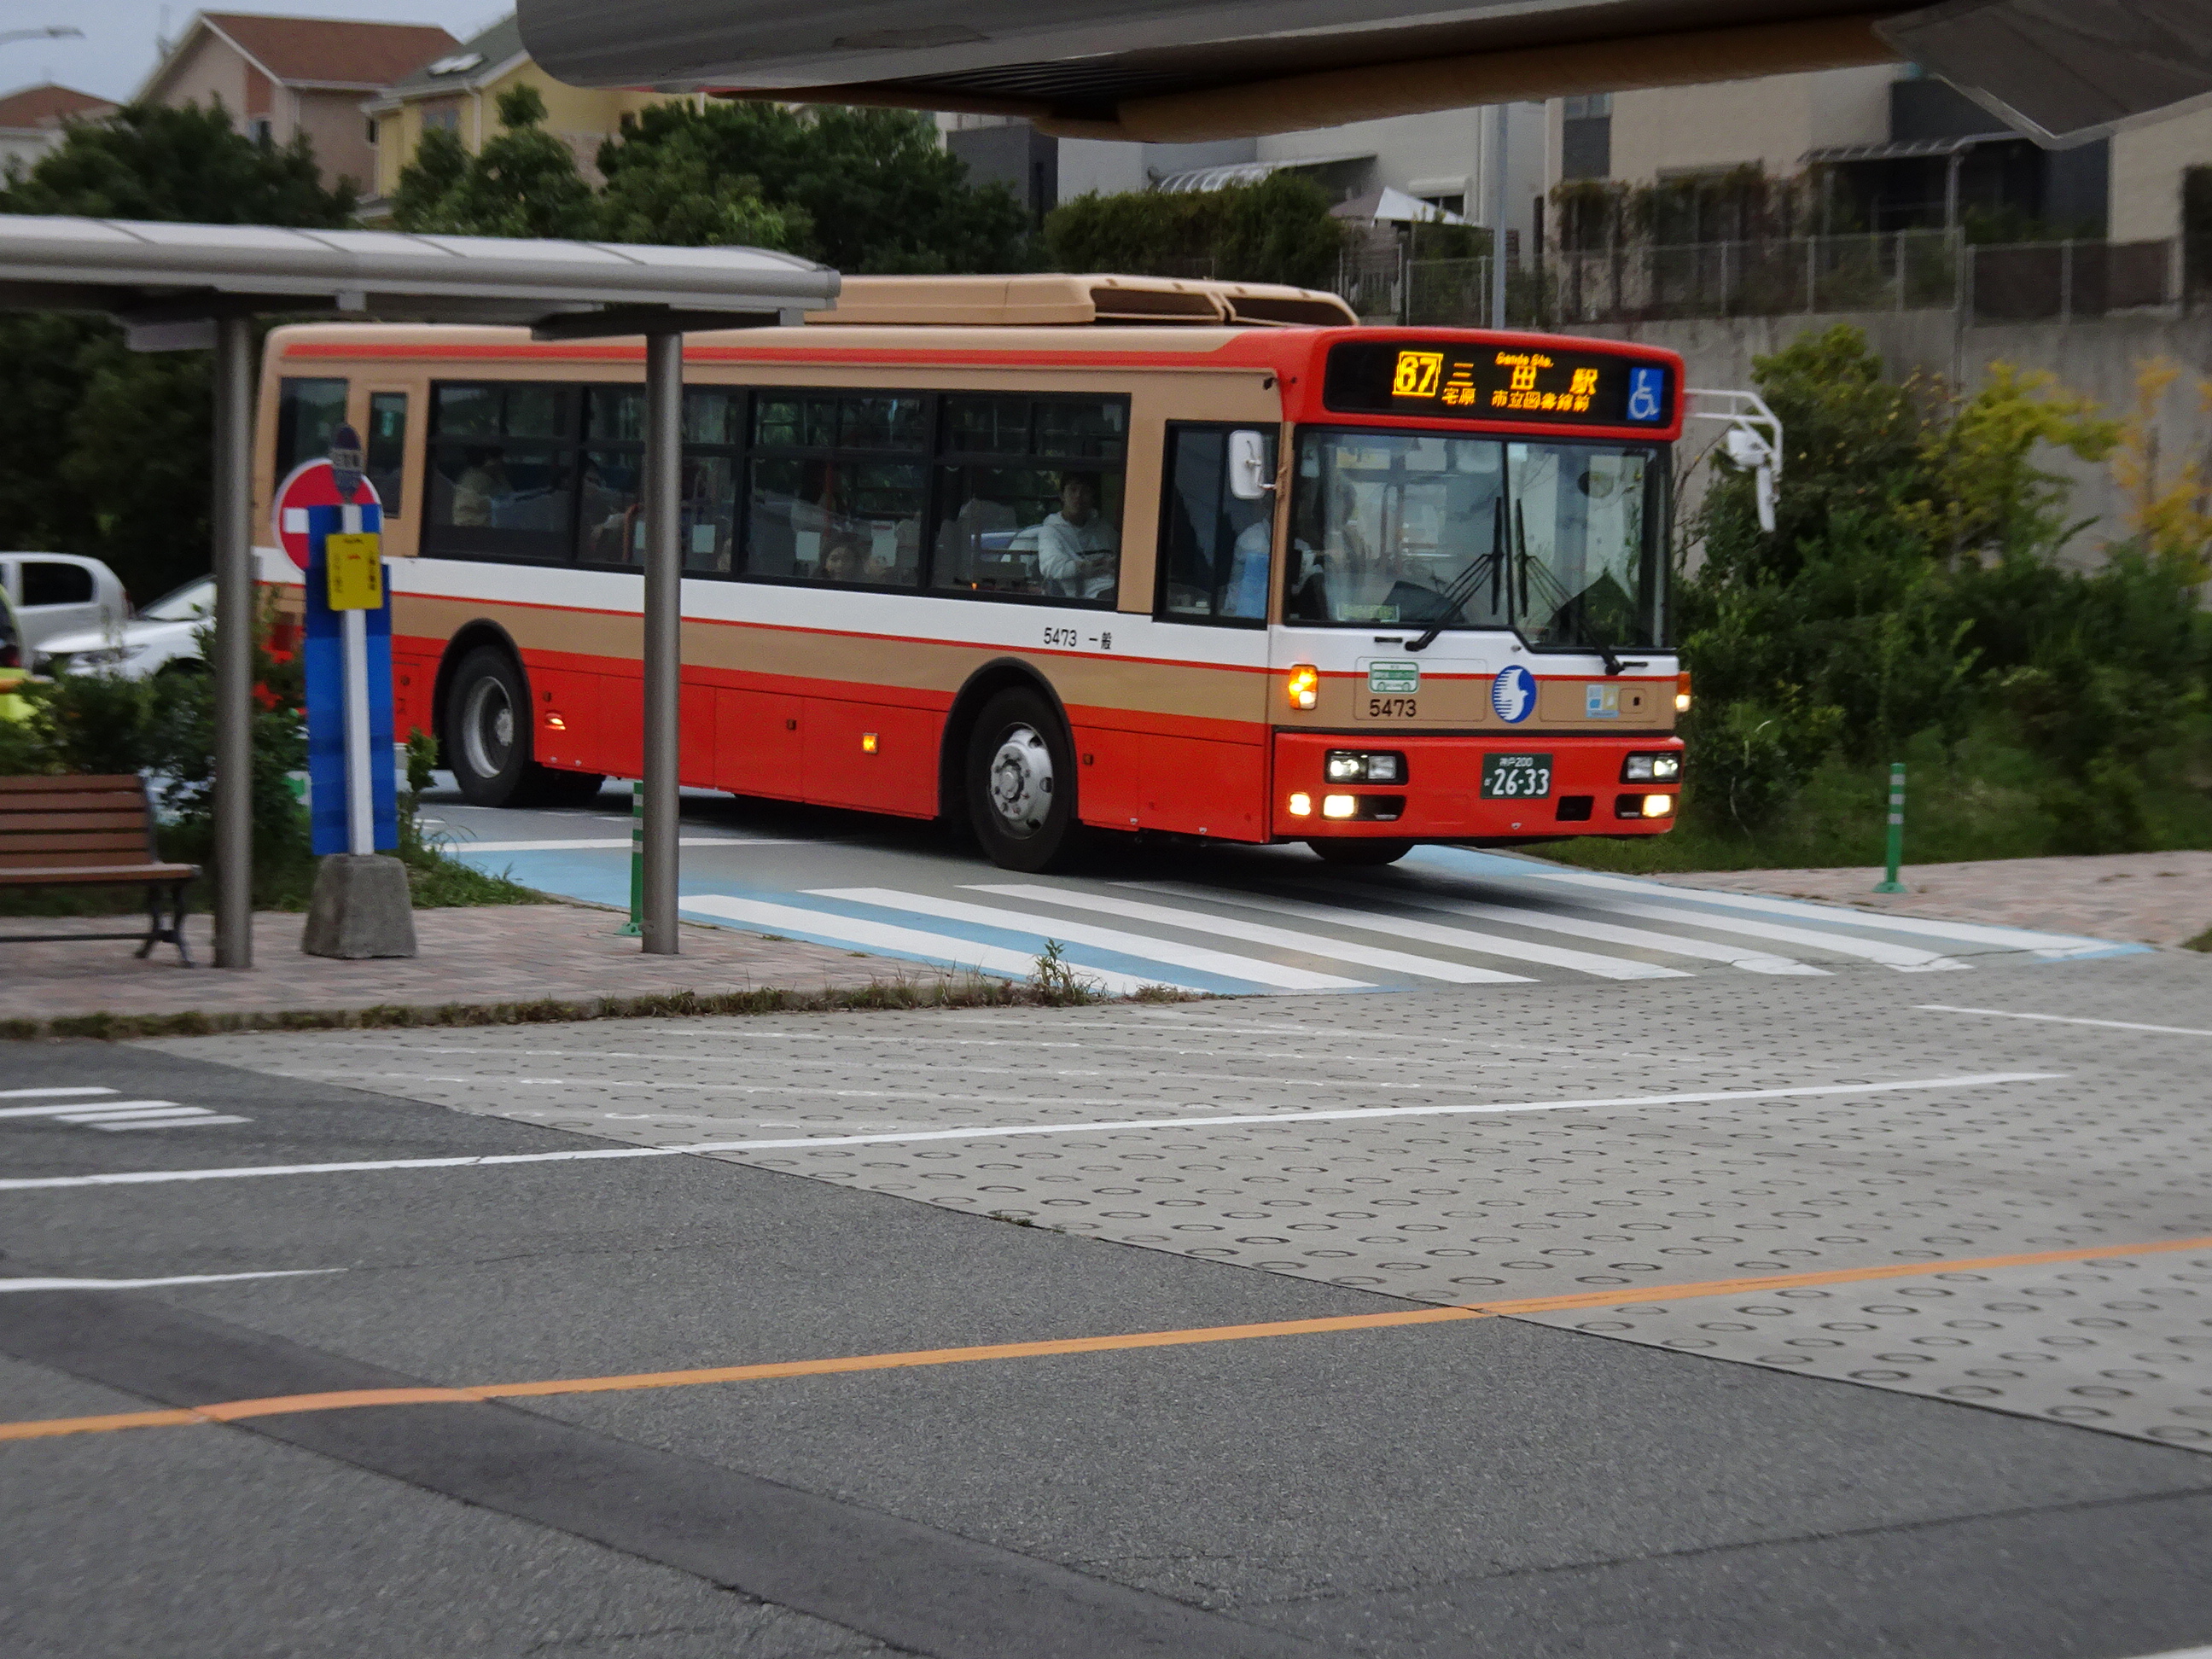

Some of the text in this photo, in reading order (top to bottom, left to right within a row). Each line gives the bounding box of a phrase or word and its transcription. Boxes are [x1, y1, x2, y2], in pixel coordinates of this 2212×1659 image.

[1396, 356, 1437, 393] 67
[1043, 627, 1078, 647] 5473
[1369, 698, 1417, 718] 5473
[1492, 767, 1550, 795] 26-33
